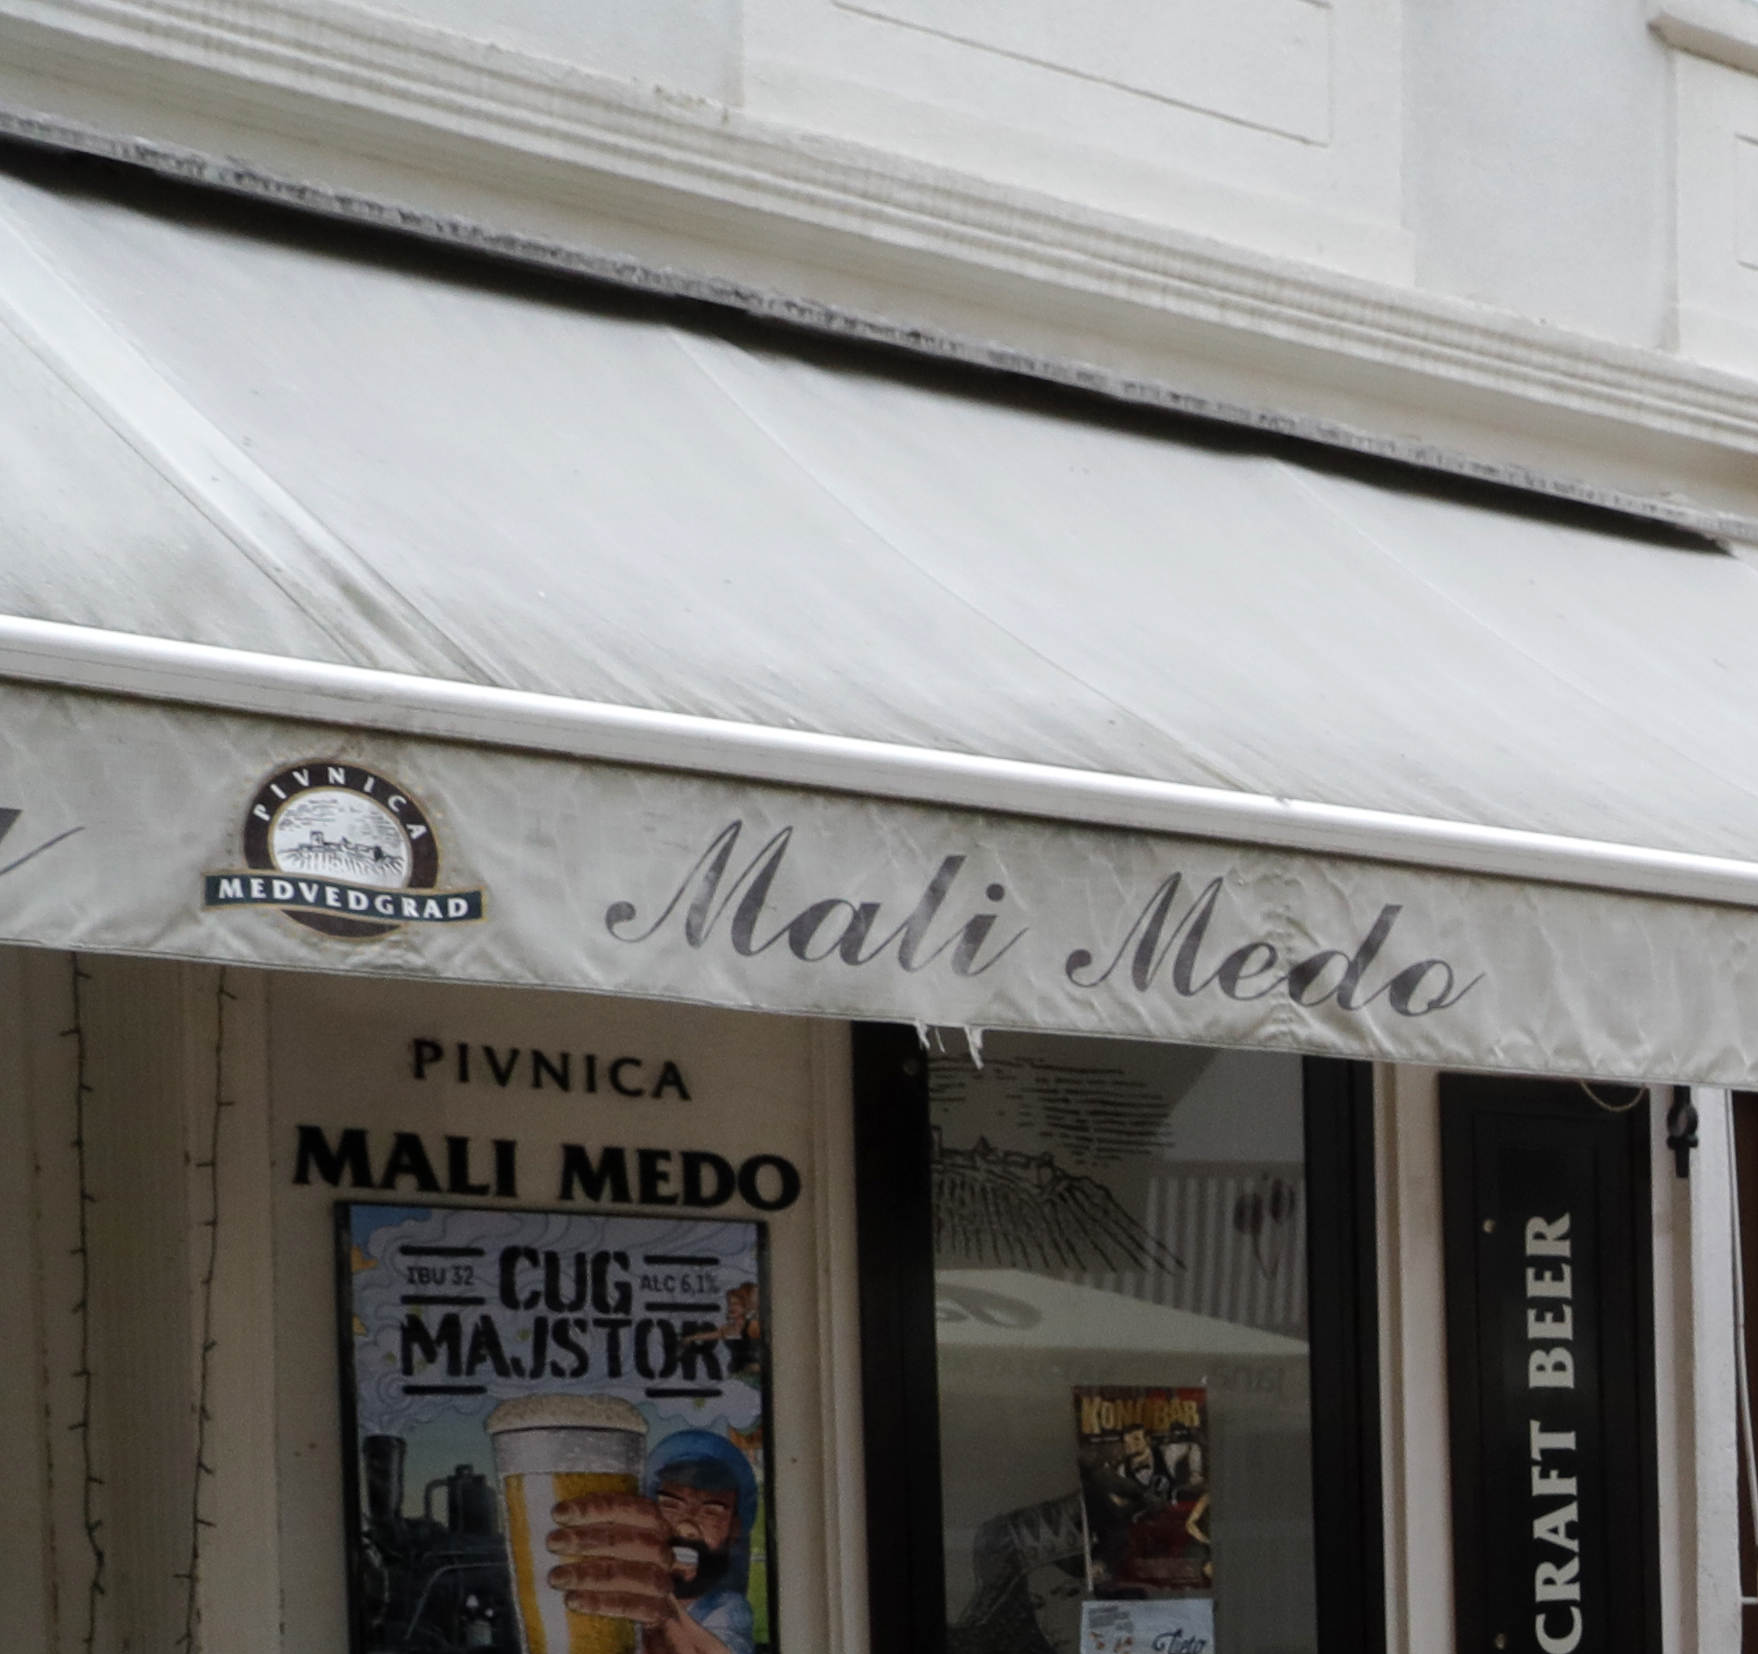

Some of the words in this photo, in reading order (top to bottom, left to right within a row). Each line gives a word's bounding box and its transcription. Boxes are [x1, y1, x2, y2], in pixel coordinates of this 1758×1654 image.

[252, 766, 428, 841] PIVNICA
[218, 877, 469, 919] MEDVEDGRAD
[604, 818, 1028, 978] Mali
[1065, 871, 1484, 1018] Medo
[411, 1038, 693, 1101] PIVNICA
[292, 1123, 519, 1199] MALI
[559, 1142, 802, 1211] MEDO
[407, 1264, 447, 1286] IBU
[452, 1265, 475, 1286] 32
[500, 1245, 633, 1315] CUG
[640, 1273, 676, 1292] ALC
[1525, 1212, 1575, 1389] BEER
[401, 1313, 723, 1381] MAJSTOR
